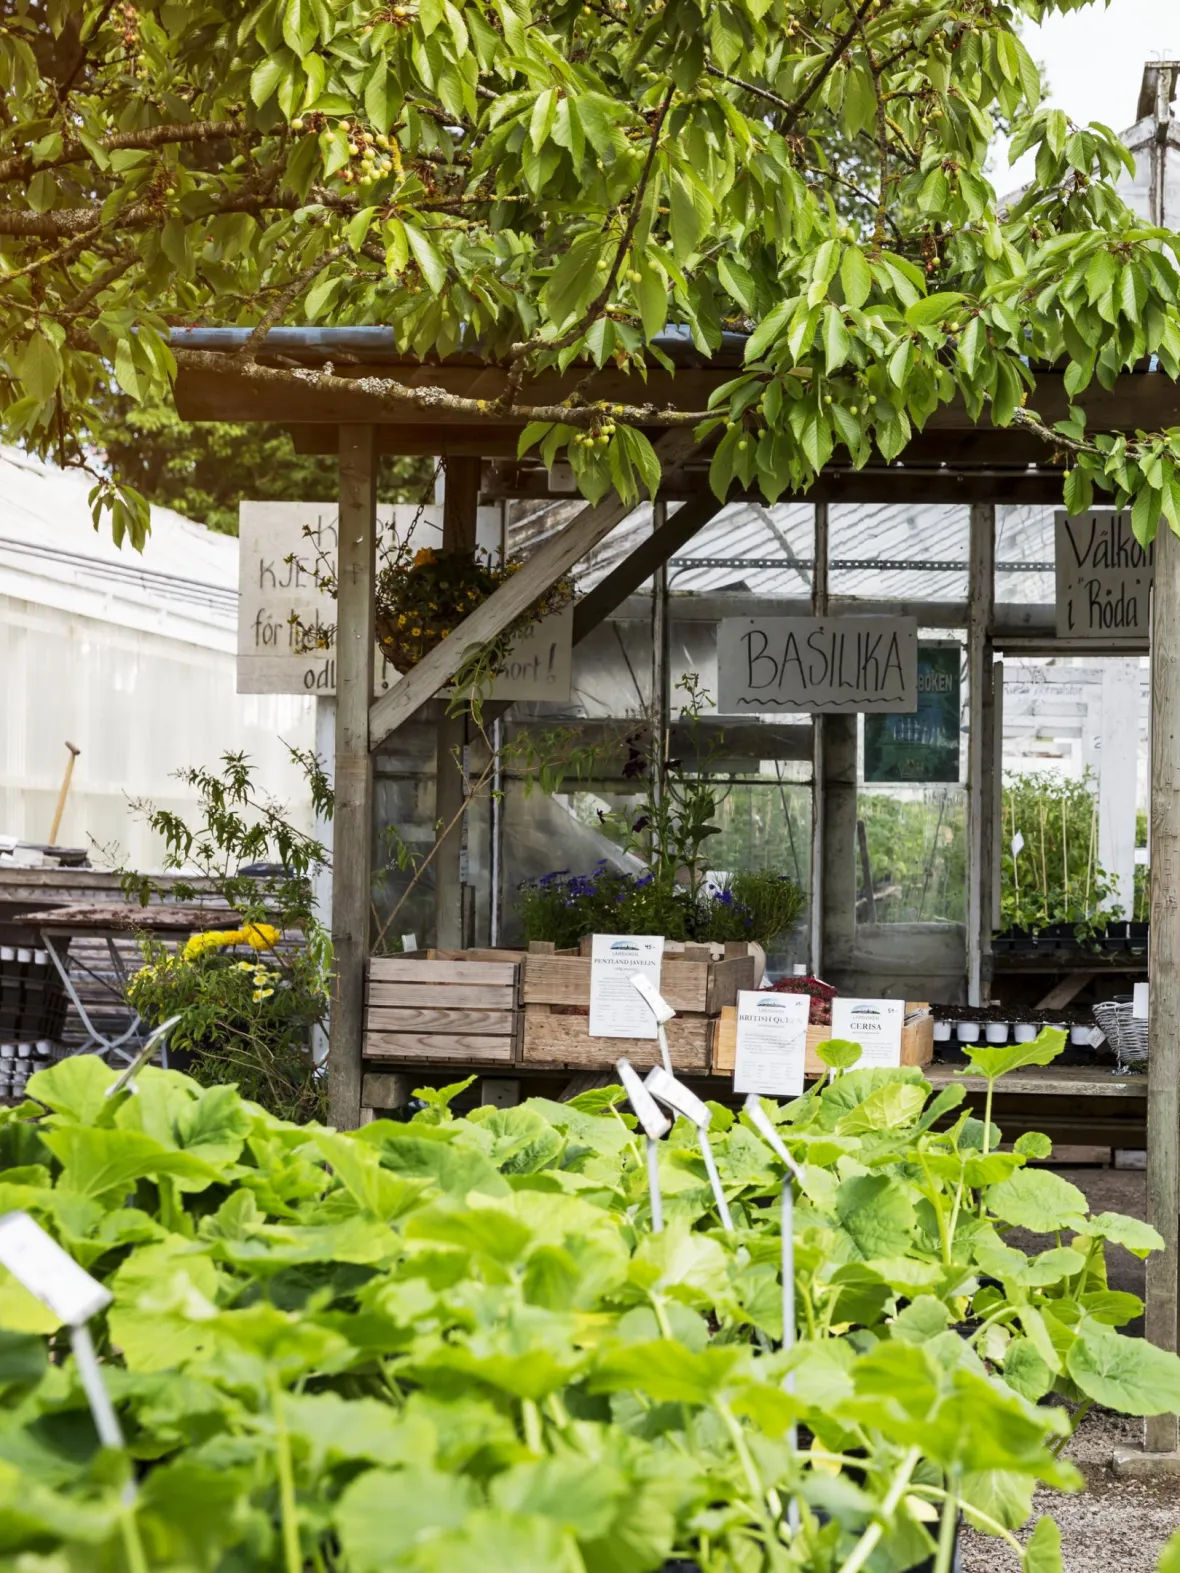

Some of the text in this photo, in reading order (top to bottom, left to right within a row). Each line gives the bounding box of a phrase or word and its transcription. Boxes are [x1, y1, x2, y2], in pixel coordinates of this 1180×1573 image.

[1068, 584, 1076, 631] i
[251, 608, 283, 646] för
[740, 630, 905, 691] BASILIKA
[739, 1014, 772, 1023] BRITISH
[850, 1022, 882, 1031] CERISA
